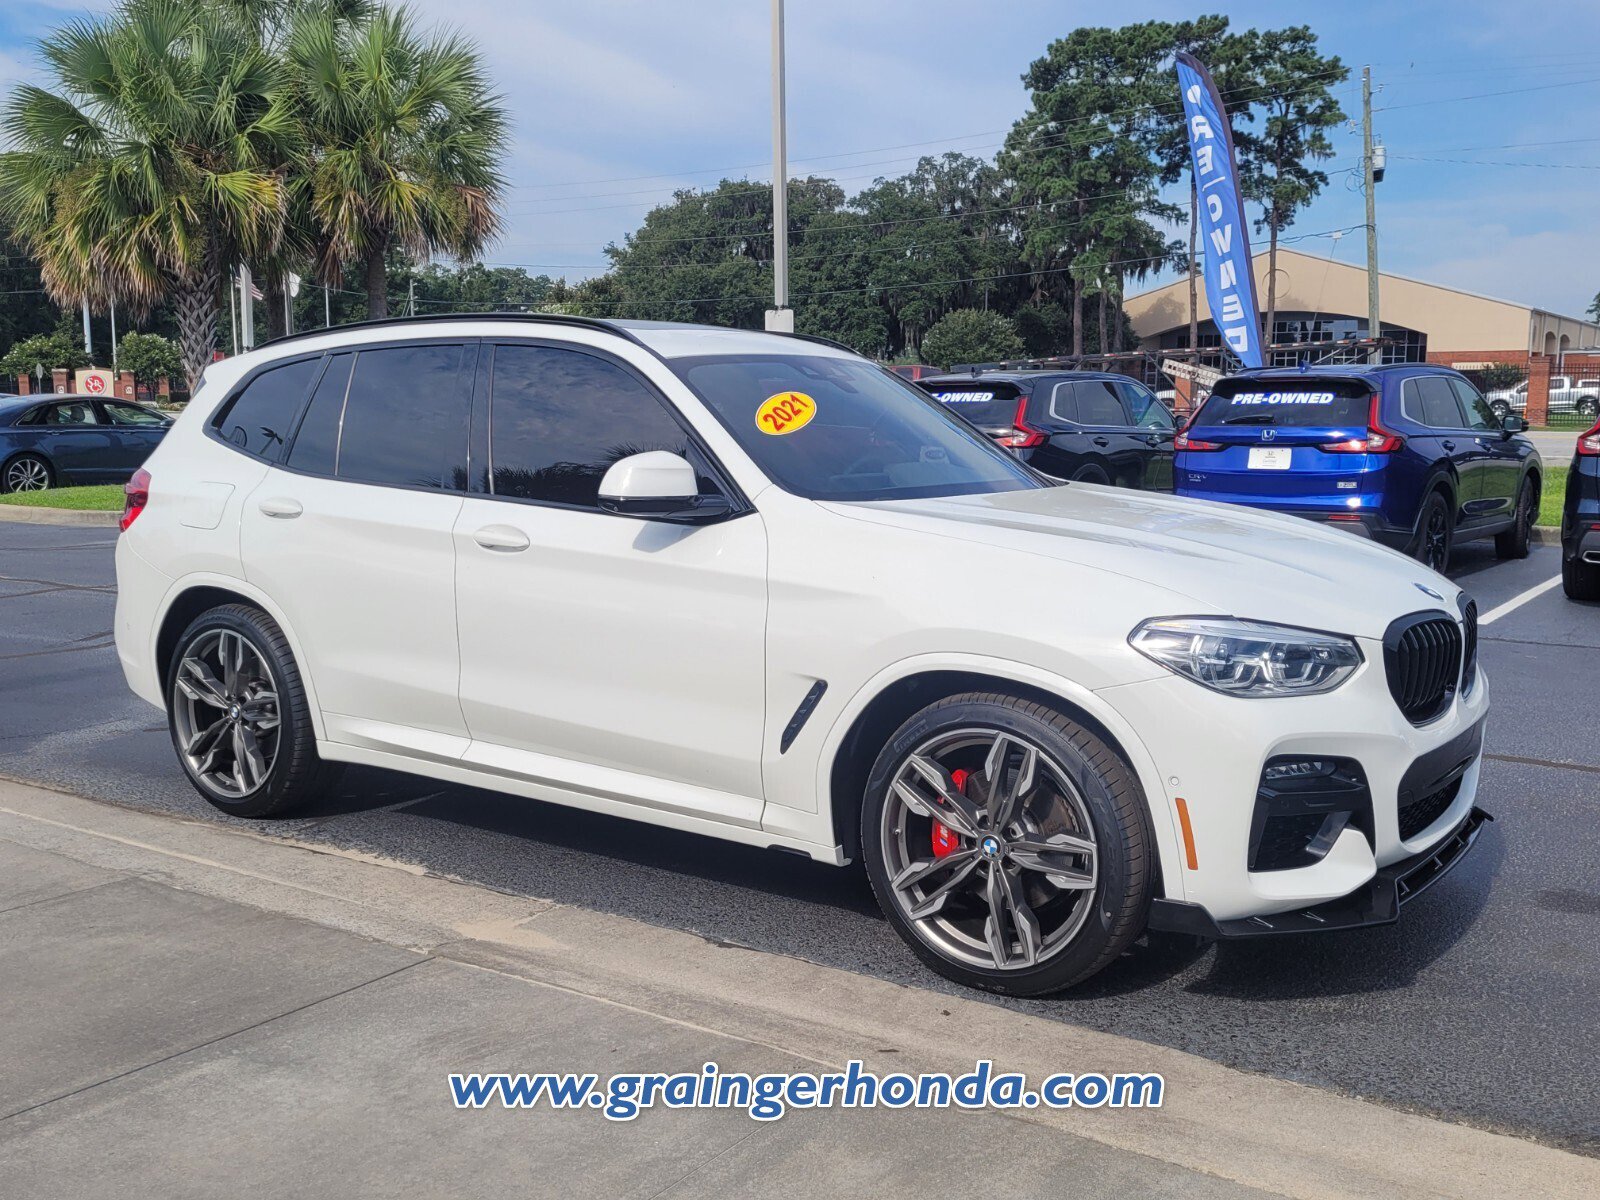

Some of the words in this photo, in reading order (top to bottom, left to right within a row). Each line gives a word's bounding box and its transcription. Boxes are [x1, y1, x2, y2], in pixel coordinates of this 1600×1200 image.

[931, 392, 994, 403] -OWNED
[1231, 392, 1334, 405] PRE-OWNED
[762, 393, 810, 432] 2021
